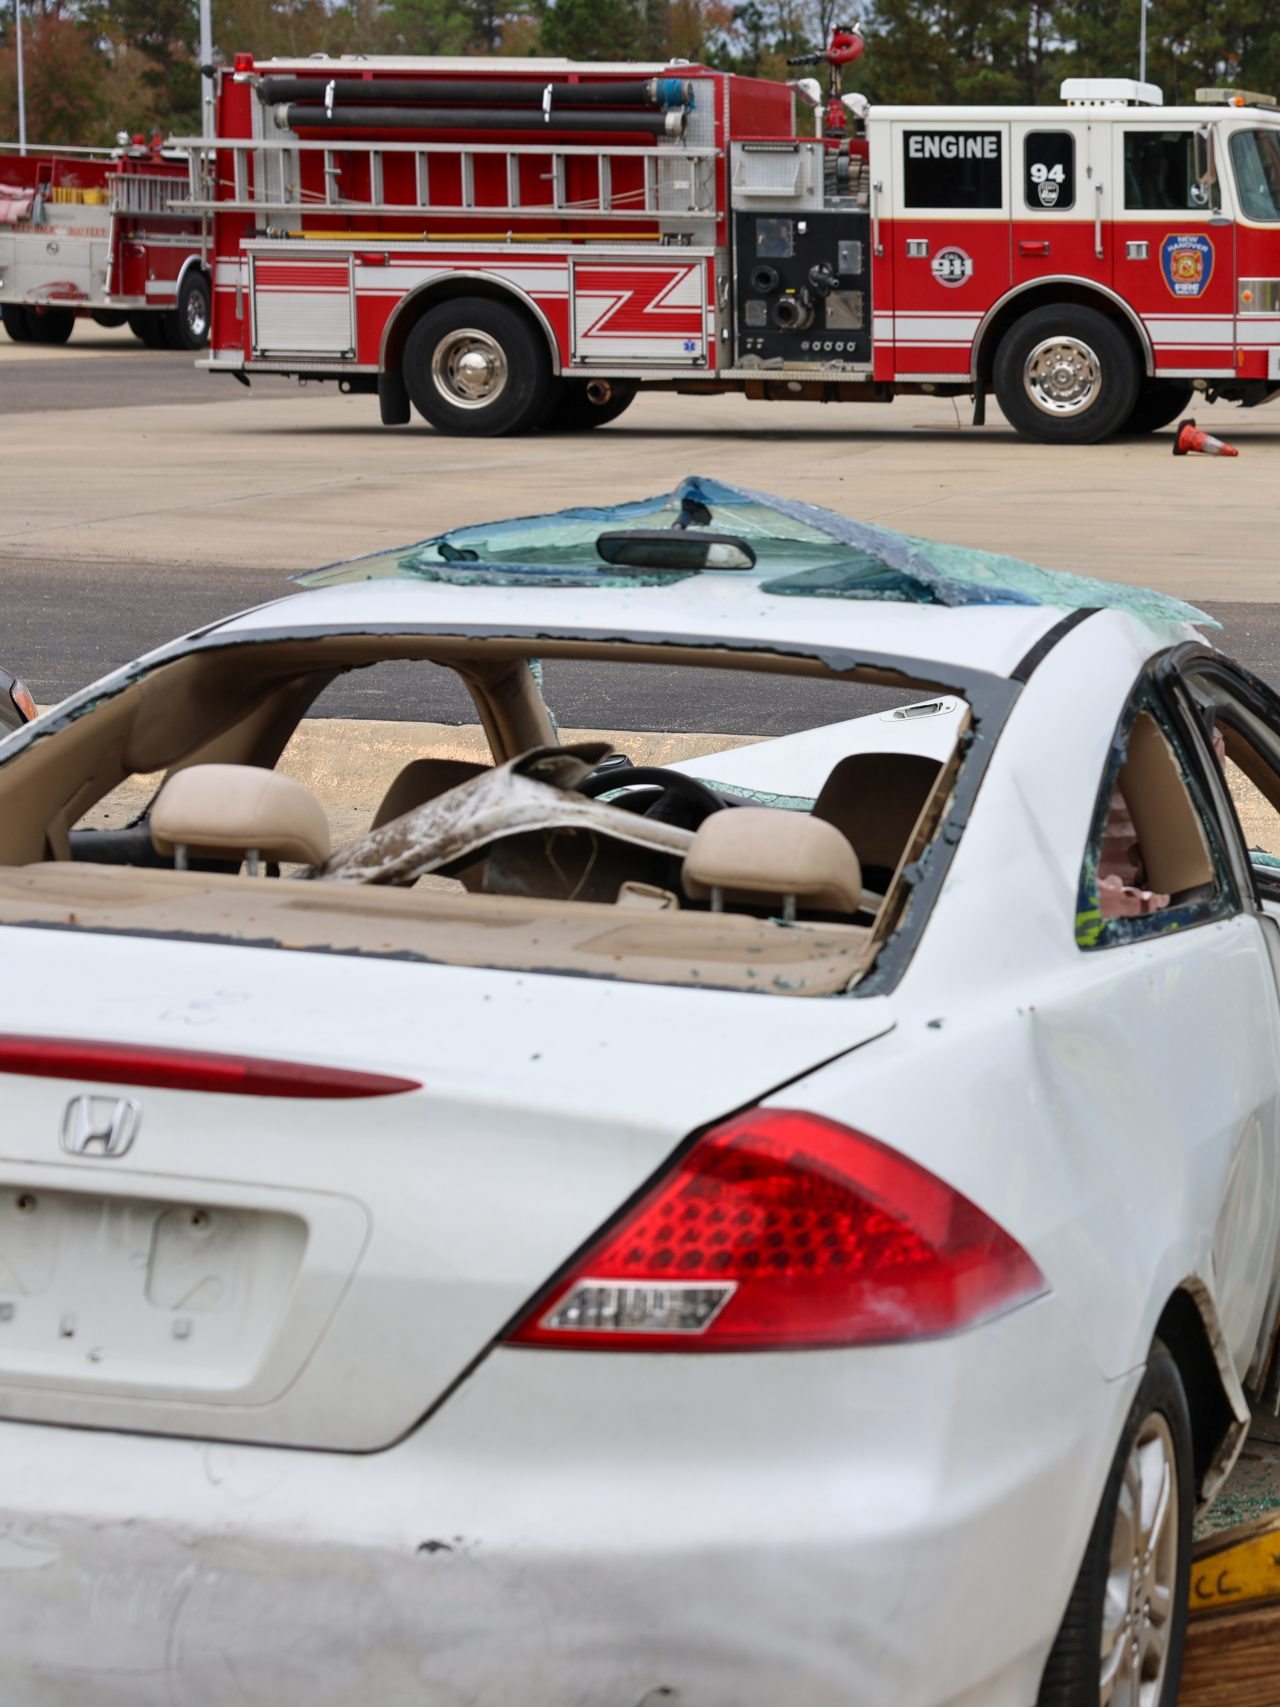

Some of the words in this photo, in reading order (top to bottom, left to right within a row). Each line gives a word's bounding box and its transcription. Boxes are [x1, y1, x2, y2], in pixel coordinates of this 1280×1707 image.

[909, 136, 998, 158] ENGINE
[1030, 163, 1065, 183] 94
[1167, 243, 1209, 252] HANOVER
[931, 259, 973, 275] 911
